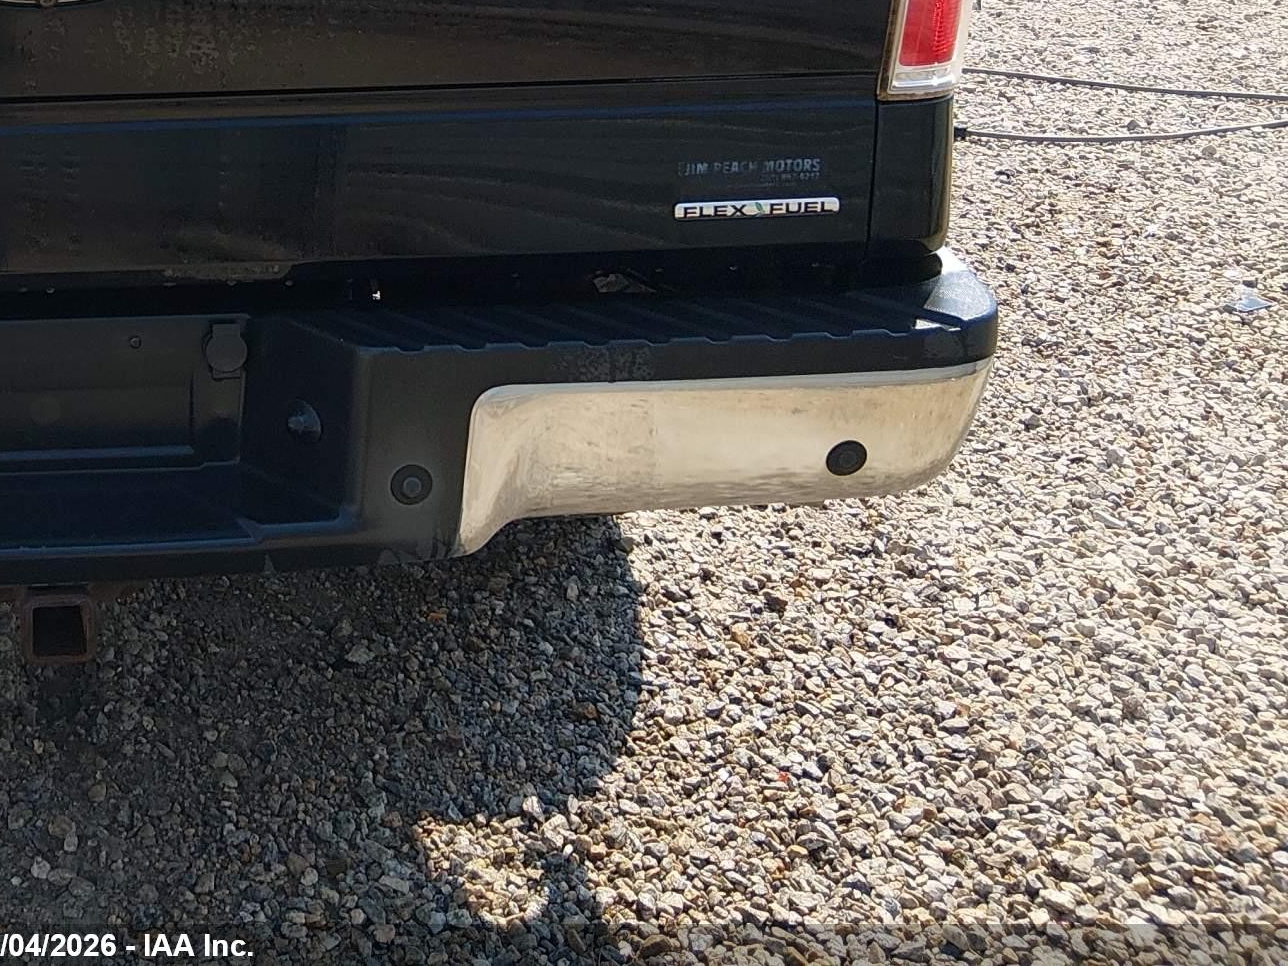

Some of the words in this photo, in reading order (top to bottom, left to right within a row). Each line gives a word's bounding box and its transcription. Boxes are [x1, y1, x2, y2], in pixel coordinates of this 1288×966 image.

[684, 162, 708, 176] JIM
[763, 158, 821, 173] MOTORS
[683, 204, 747, 218] FLEX
[769, 201, 835, 215] FUEL
